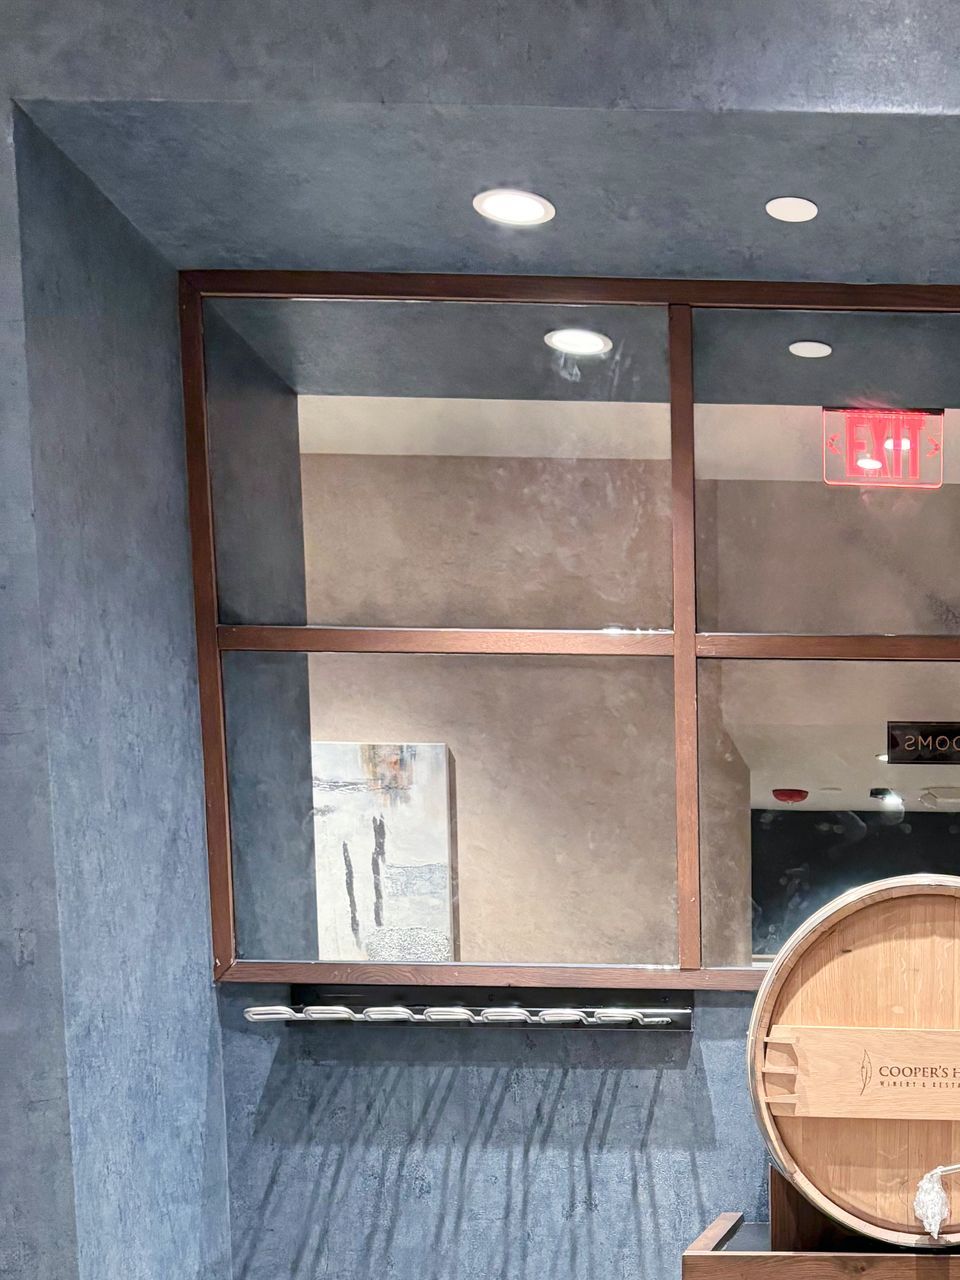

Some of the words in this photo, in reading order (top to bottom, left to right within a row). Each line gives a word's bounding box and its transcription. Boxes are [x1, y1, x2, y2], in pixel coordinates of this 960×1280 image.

[845, 413, 926, 480] EXIT
[878, 1065, 949, 1079] COOPER'S
[879, 1080, 916, 1088] WINERY
